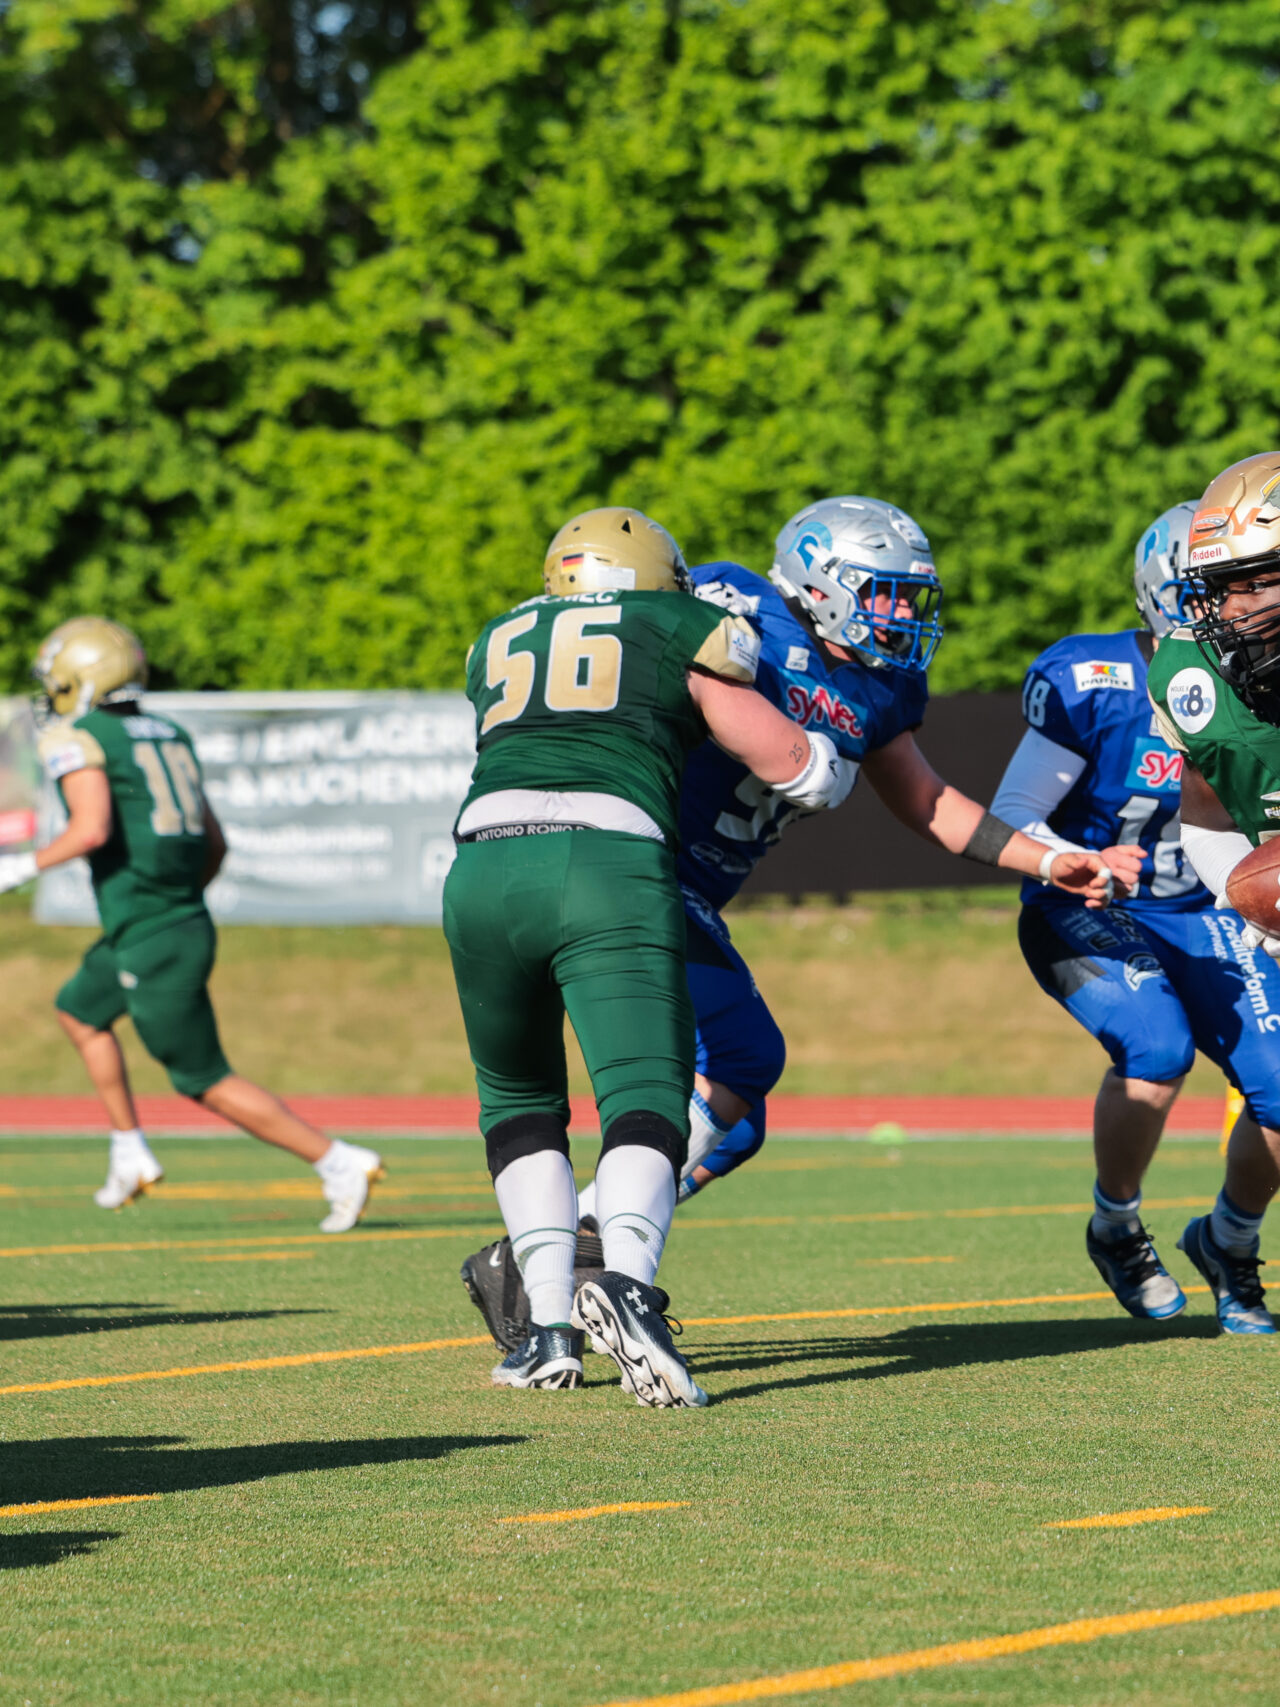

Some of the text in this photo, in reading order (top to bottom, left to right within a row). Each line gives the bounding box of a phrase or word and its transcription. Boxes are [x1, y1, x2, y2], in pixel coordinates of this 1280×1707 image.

[1192, 547, 1222, 561] Riddell
[483, 604, 623, 734] 56
[475, 825, 524, 842] ANTONIO
